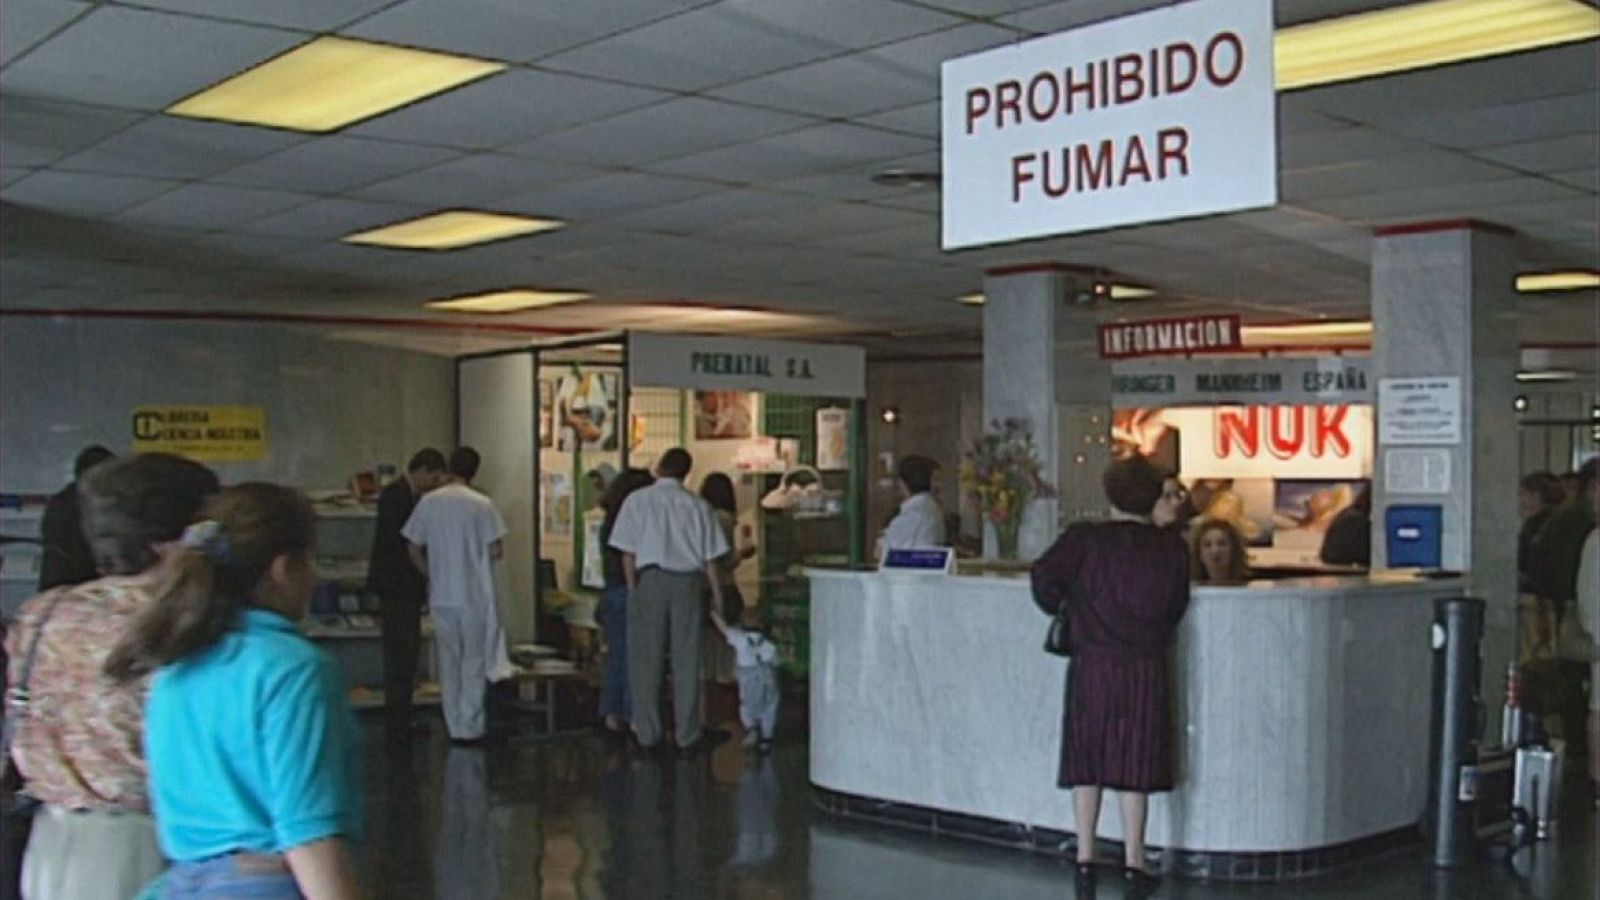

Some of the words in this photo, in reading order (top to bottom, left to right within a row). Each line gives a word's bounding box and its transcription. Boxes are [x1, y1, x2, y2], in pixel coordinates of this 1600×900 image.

[966, 31, 1244, 134] PROHIBIDO
[1012, 126, 1190, 202] FUMAR
[1104, 319, 1232, 354] INFORMACION
[1196, 373, 1282, 392] MANNHEIM
[1303, 367, 1367, 392] ESPAÑA
[1215, 405, 1351, 458] NUK
